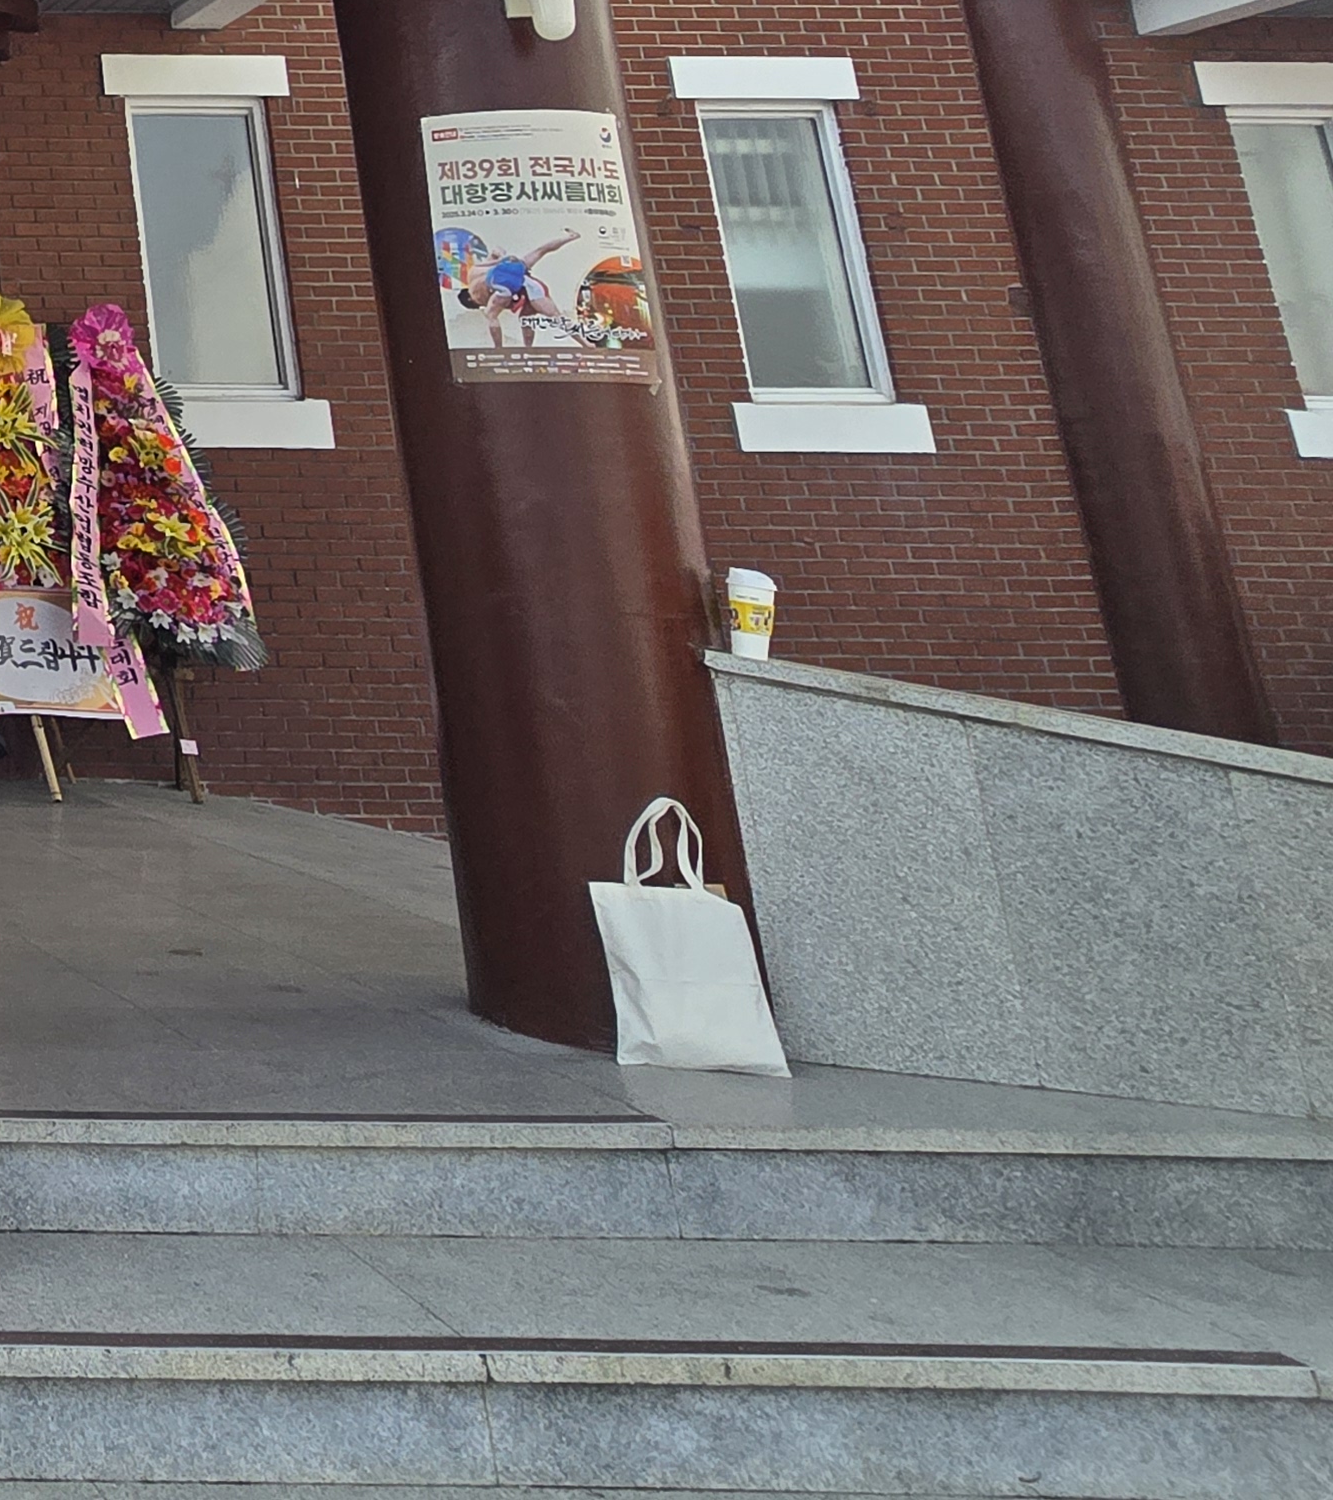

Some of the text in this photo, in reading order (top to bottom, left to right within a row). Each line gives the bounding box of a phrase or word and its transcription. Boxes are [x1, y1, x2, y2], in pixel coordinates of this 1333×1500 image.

[437, 156, 621, 181] 제39회 전국시·도
[440, 180, 624, 206] 대항장사씨름대회
